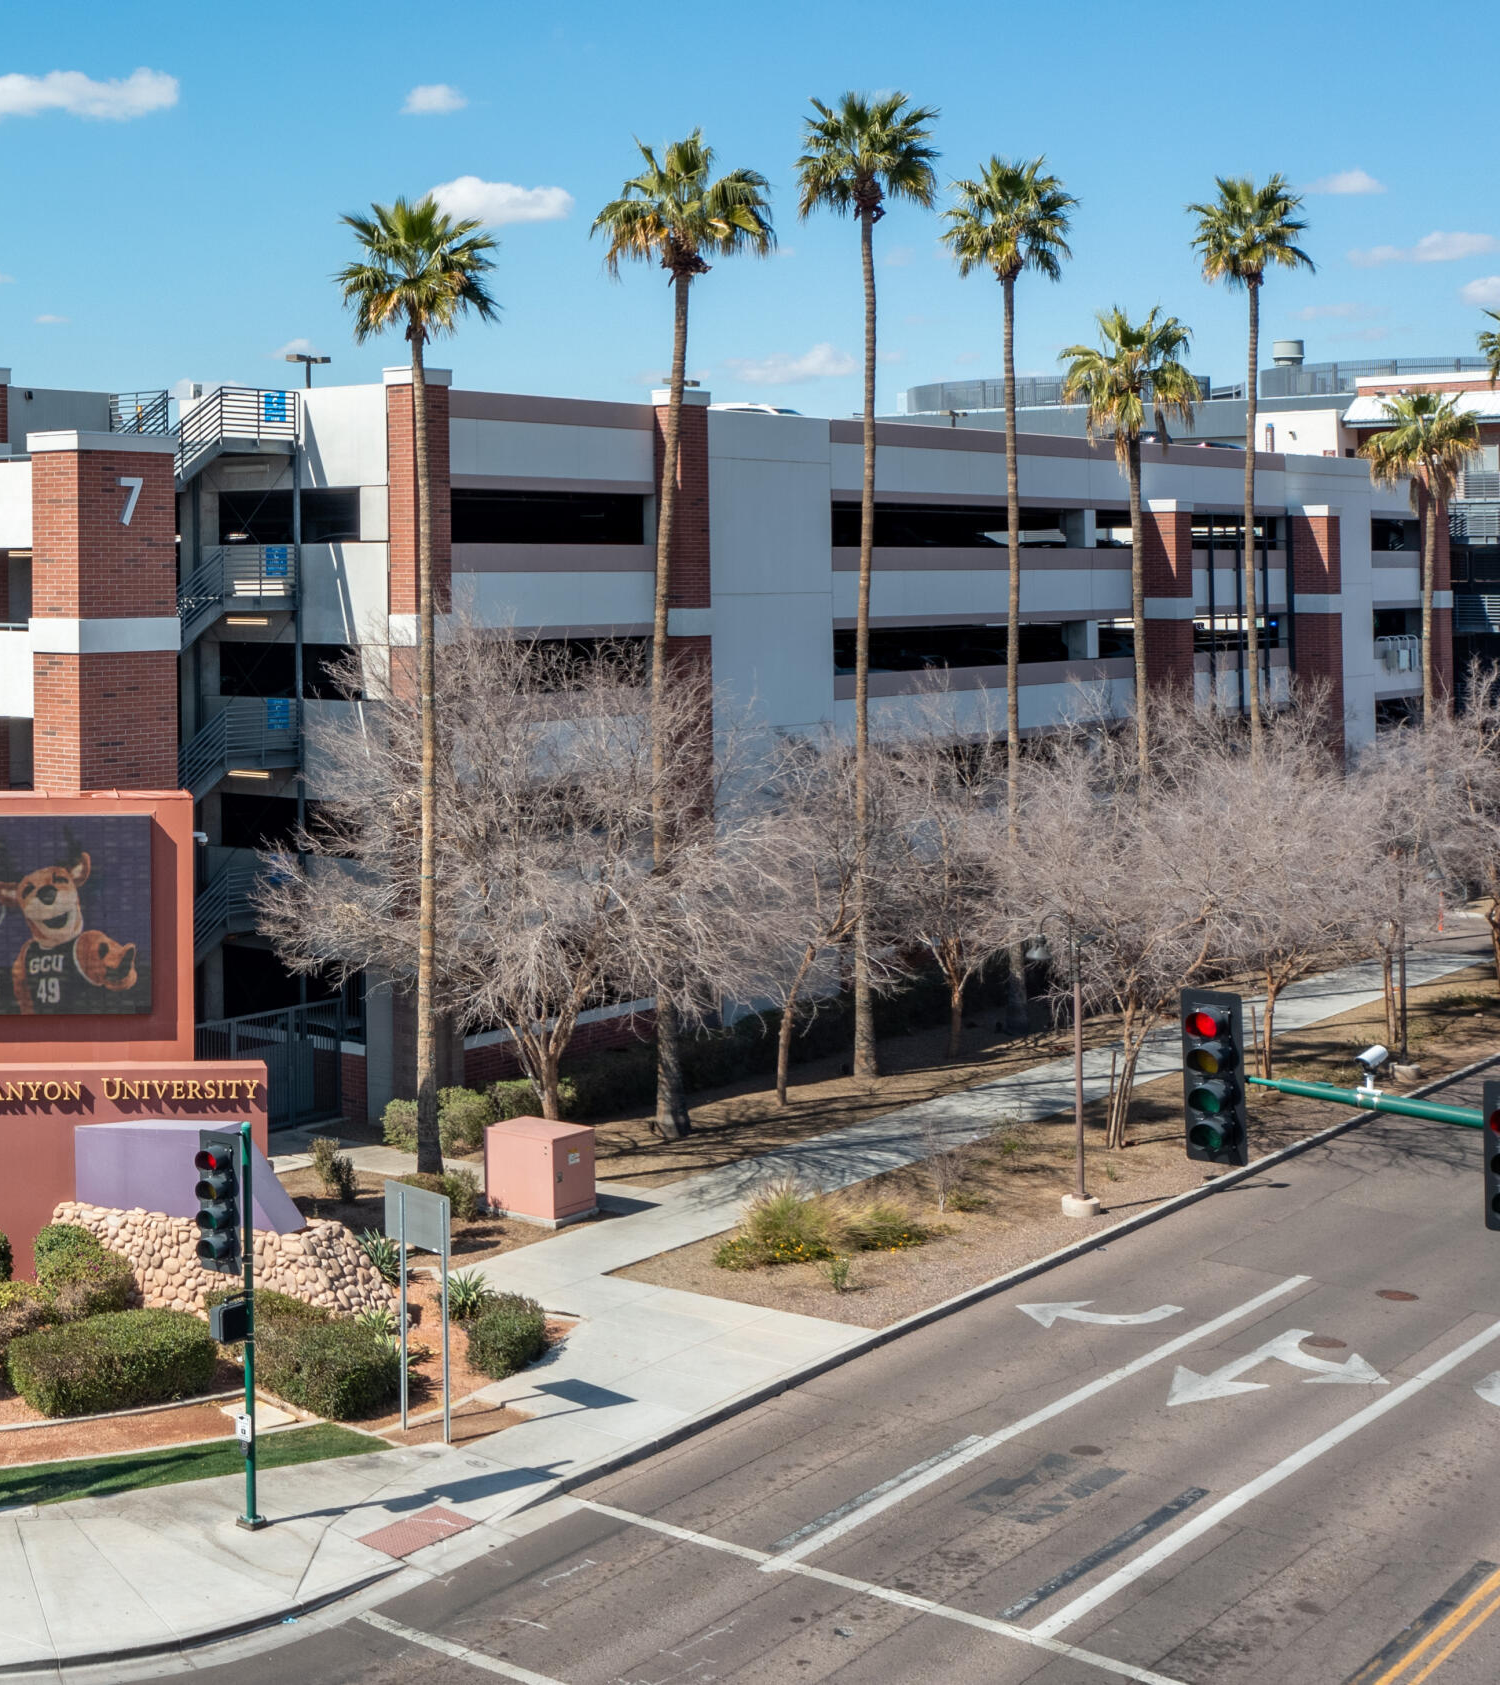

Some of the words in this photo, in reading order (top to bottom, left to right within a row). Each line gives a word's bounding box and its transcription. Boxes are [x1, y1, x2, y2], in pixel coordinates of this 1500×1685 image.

[116, 477, 143, 526] 7
[29, 955, 64, 974] GCU
[37, 977, 60, 1003] 49
[102, 1077, 259, 1100] UNIVERSITY
